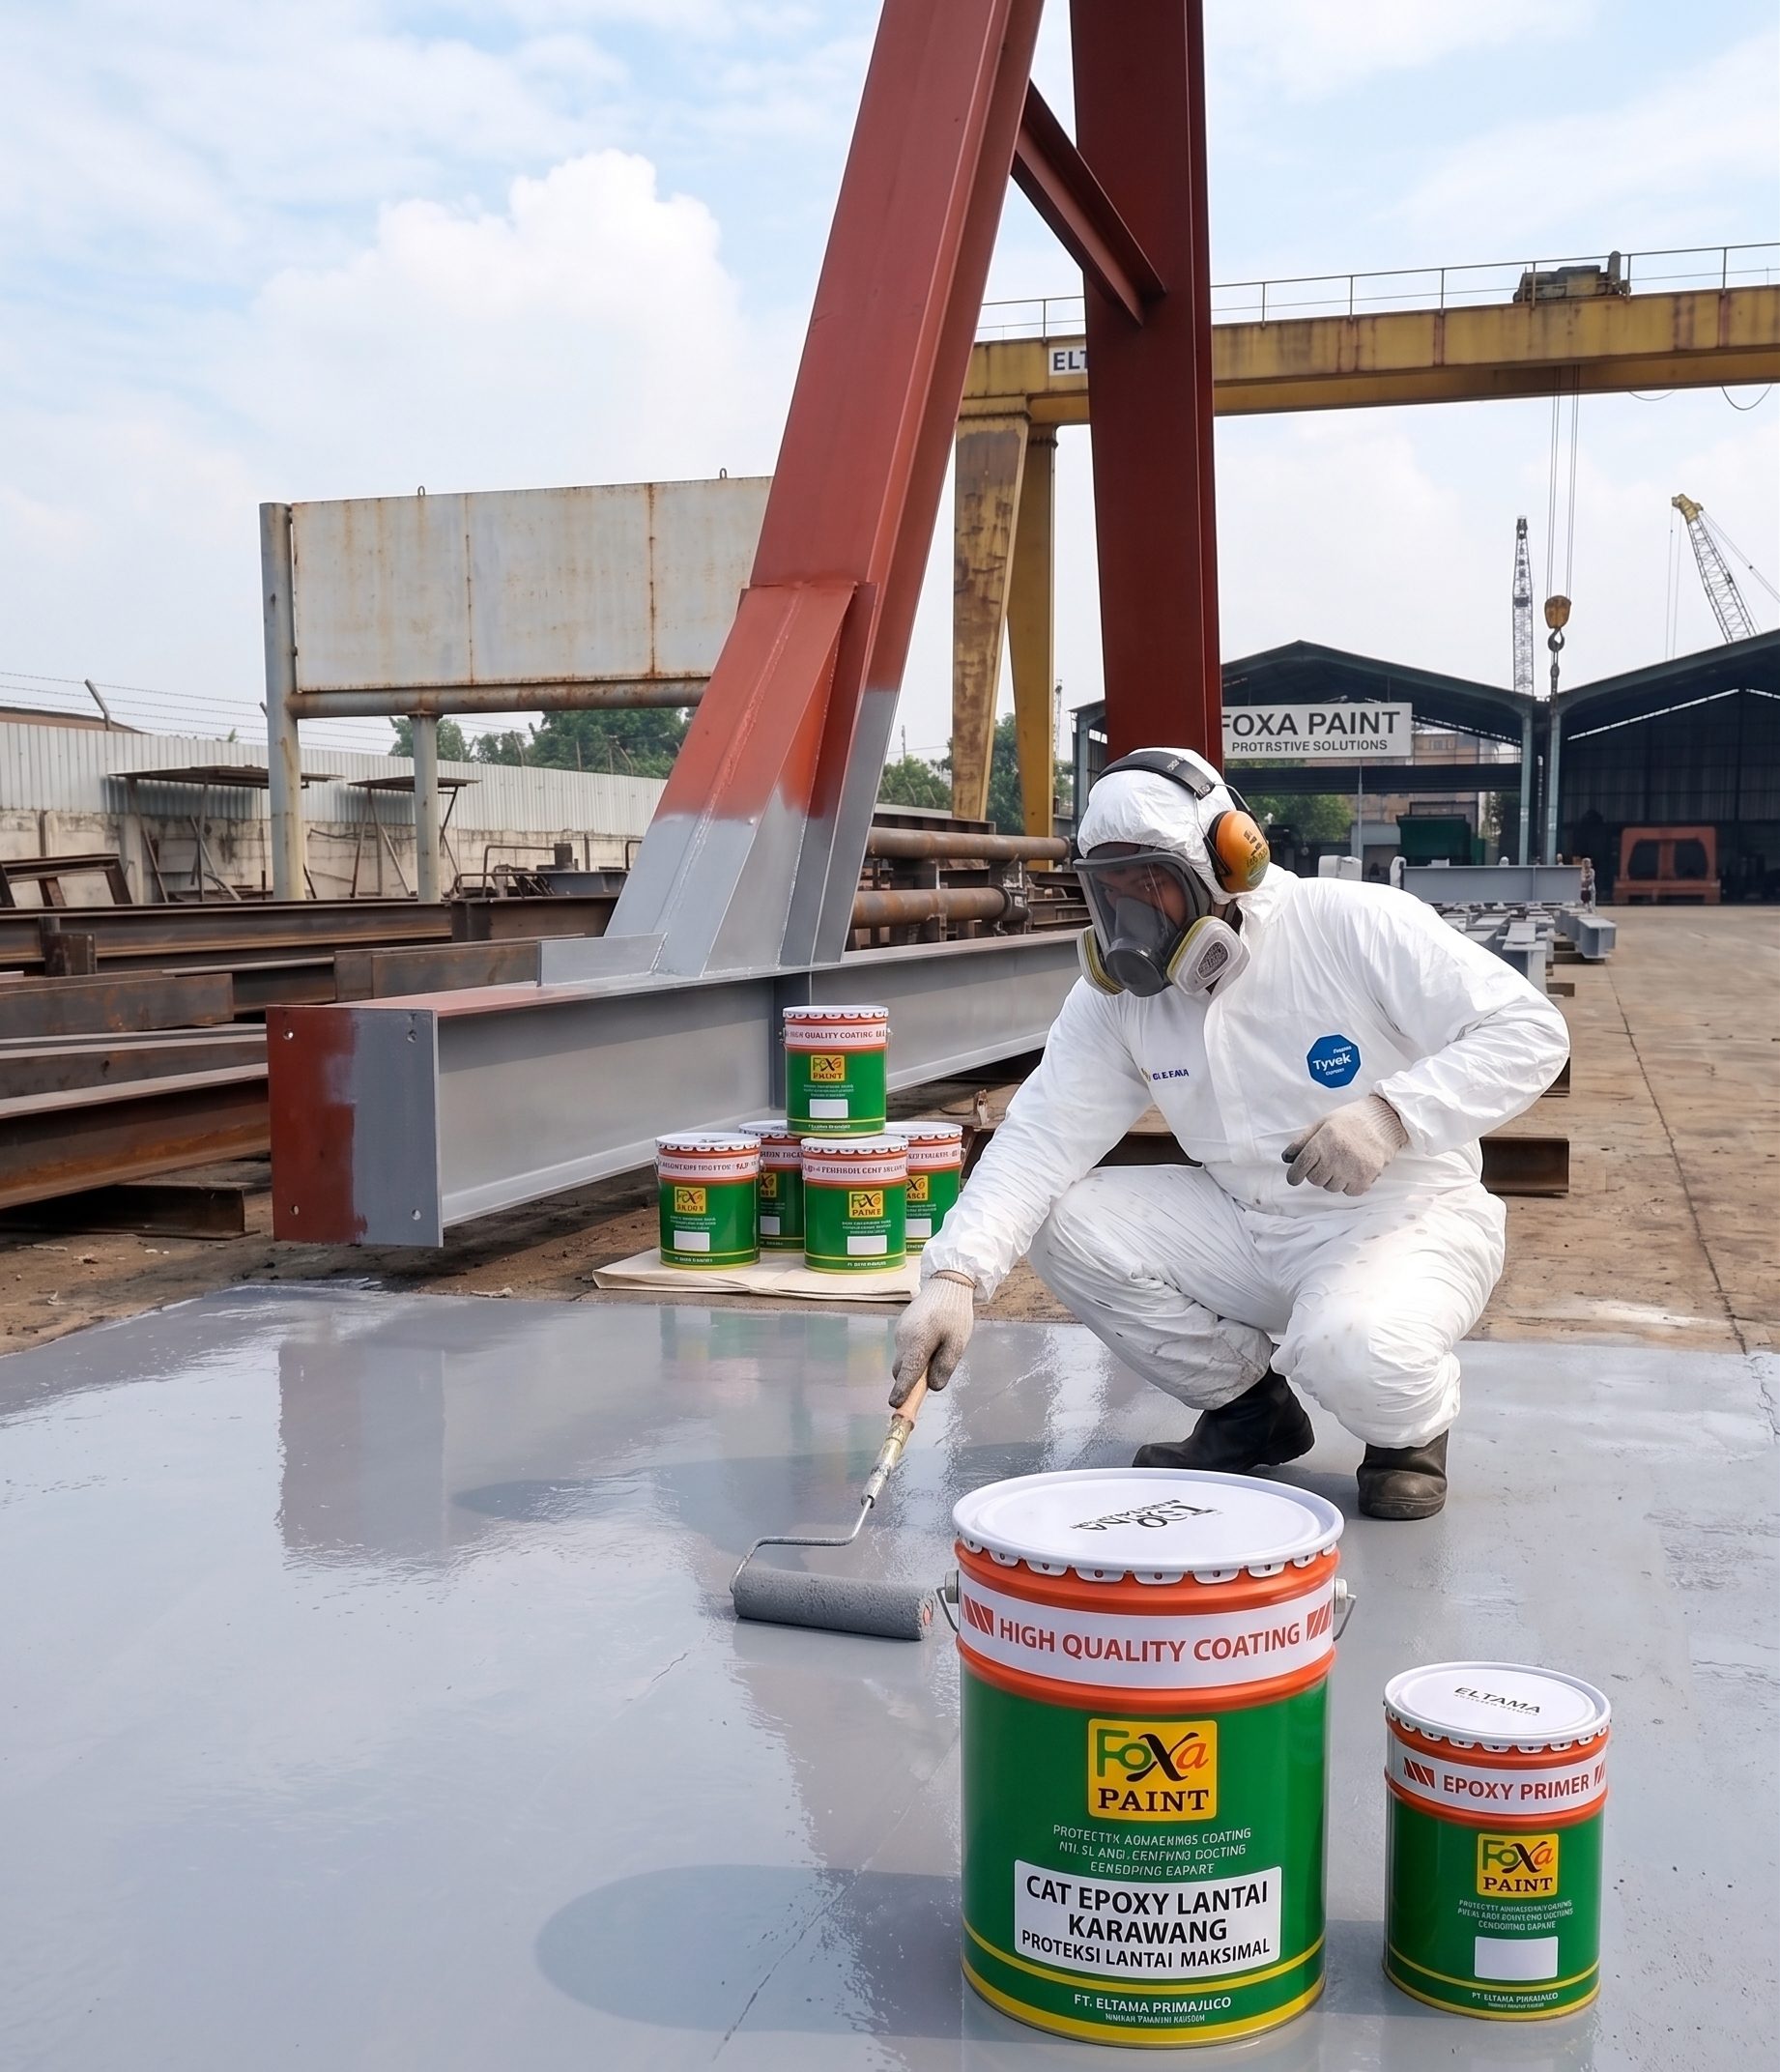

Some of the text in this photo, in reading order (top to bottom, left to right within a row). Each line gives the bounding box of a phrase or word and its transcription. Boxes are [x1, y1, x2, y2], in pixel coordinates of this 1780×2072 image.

[1308, 711, 1401, 735] PAINT
[1313, 739, 1388, 752] SOLUTIONS
[1312, 1052, 1352, 1072] Tyvek
[999, 1618, 1301, 1663] HIGH QUALITY COATING
[1453, 1686, 1541, 1713] ELTAMA
[1443, 1773, 1590, 1800] EPOXY PRIMER
[1098, 1788, 1209, 1812] PAINT
[1202, 1827, 1251, 1845] COATING
[1026, 1875, 1269, 1915] CAT EPOXY LANTAI
[1483, 1877, 1553, 1892] PAINT
[1069, 1914, 1228, 1944] KARAWANG
[1021, 1928, 1271, 1969] PROTEKSI LANTAI MAKSIMAL
[1096, 1998, 1149, 2013] ELTAMA
[1483, 1994, 1514, 2003] ELTAMA
